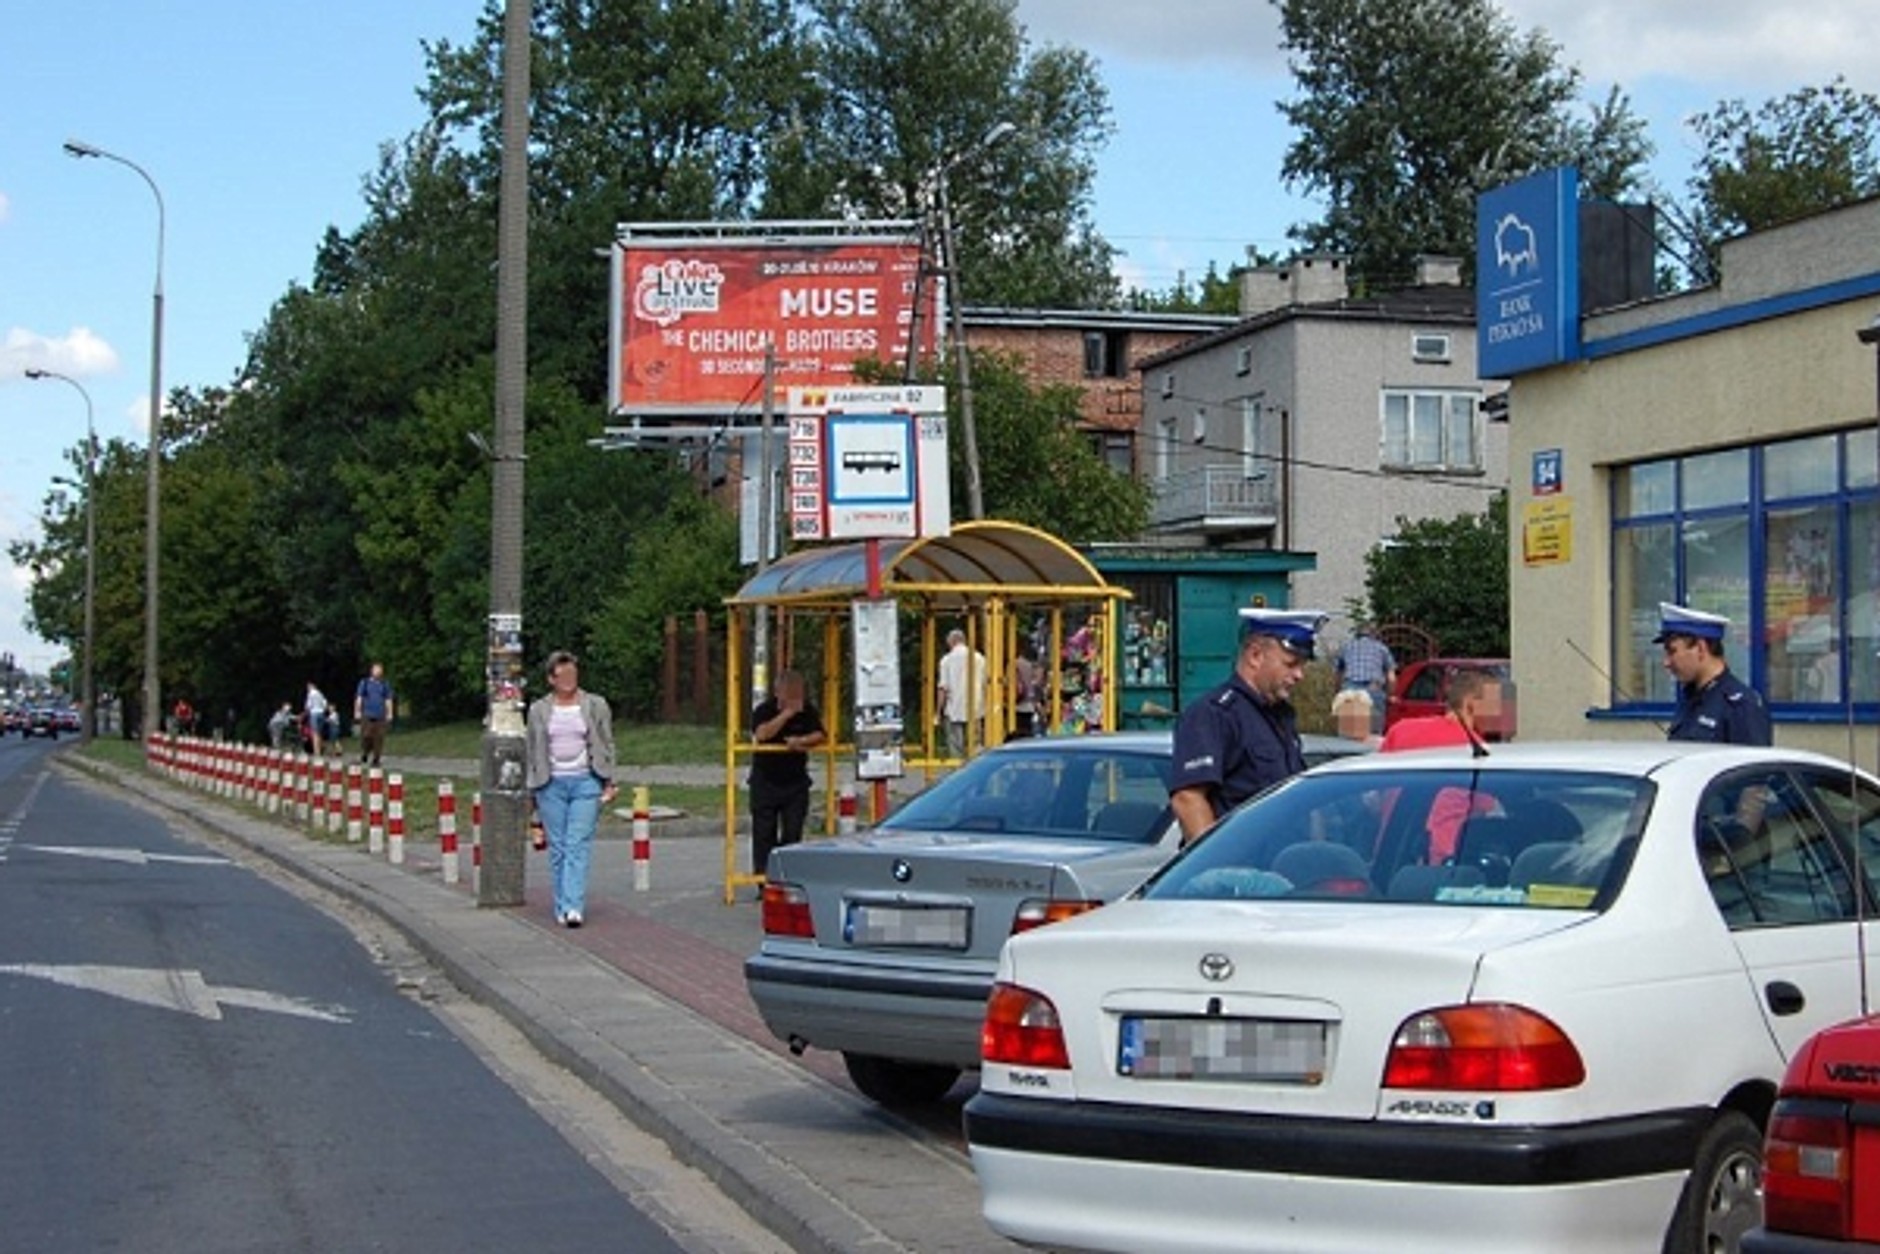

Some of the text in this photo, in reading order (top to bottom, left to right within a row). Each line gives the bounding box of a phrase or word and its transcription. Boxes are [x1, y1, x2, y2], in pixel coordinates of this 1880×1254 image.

[780, 288, 879, 318] MUSE
[688, 329, 778, 353] CHEMICAL
[786, 329, 879, 352] BROTHERS
